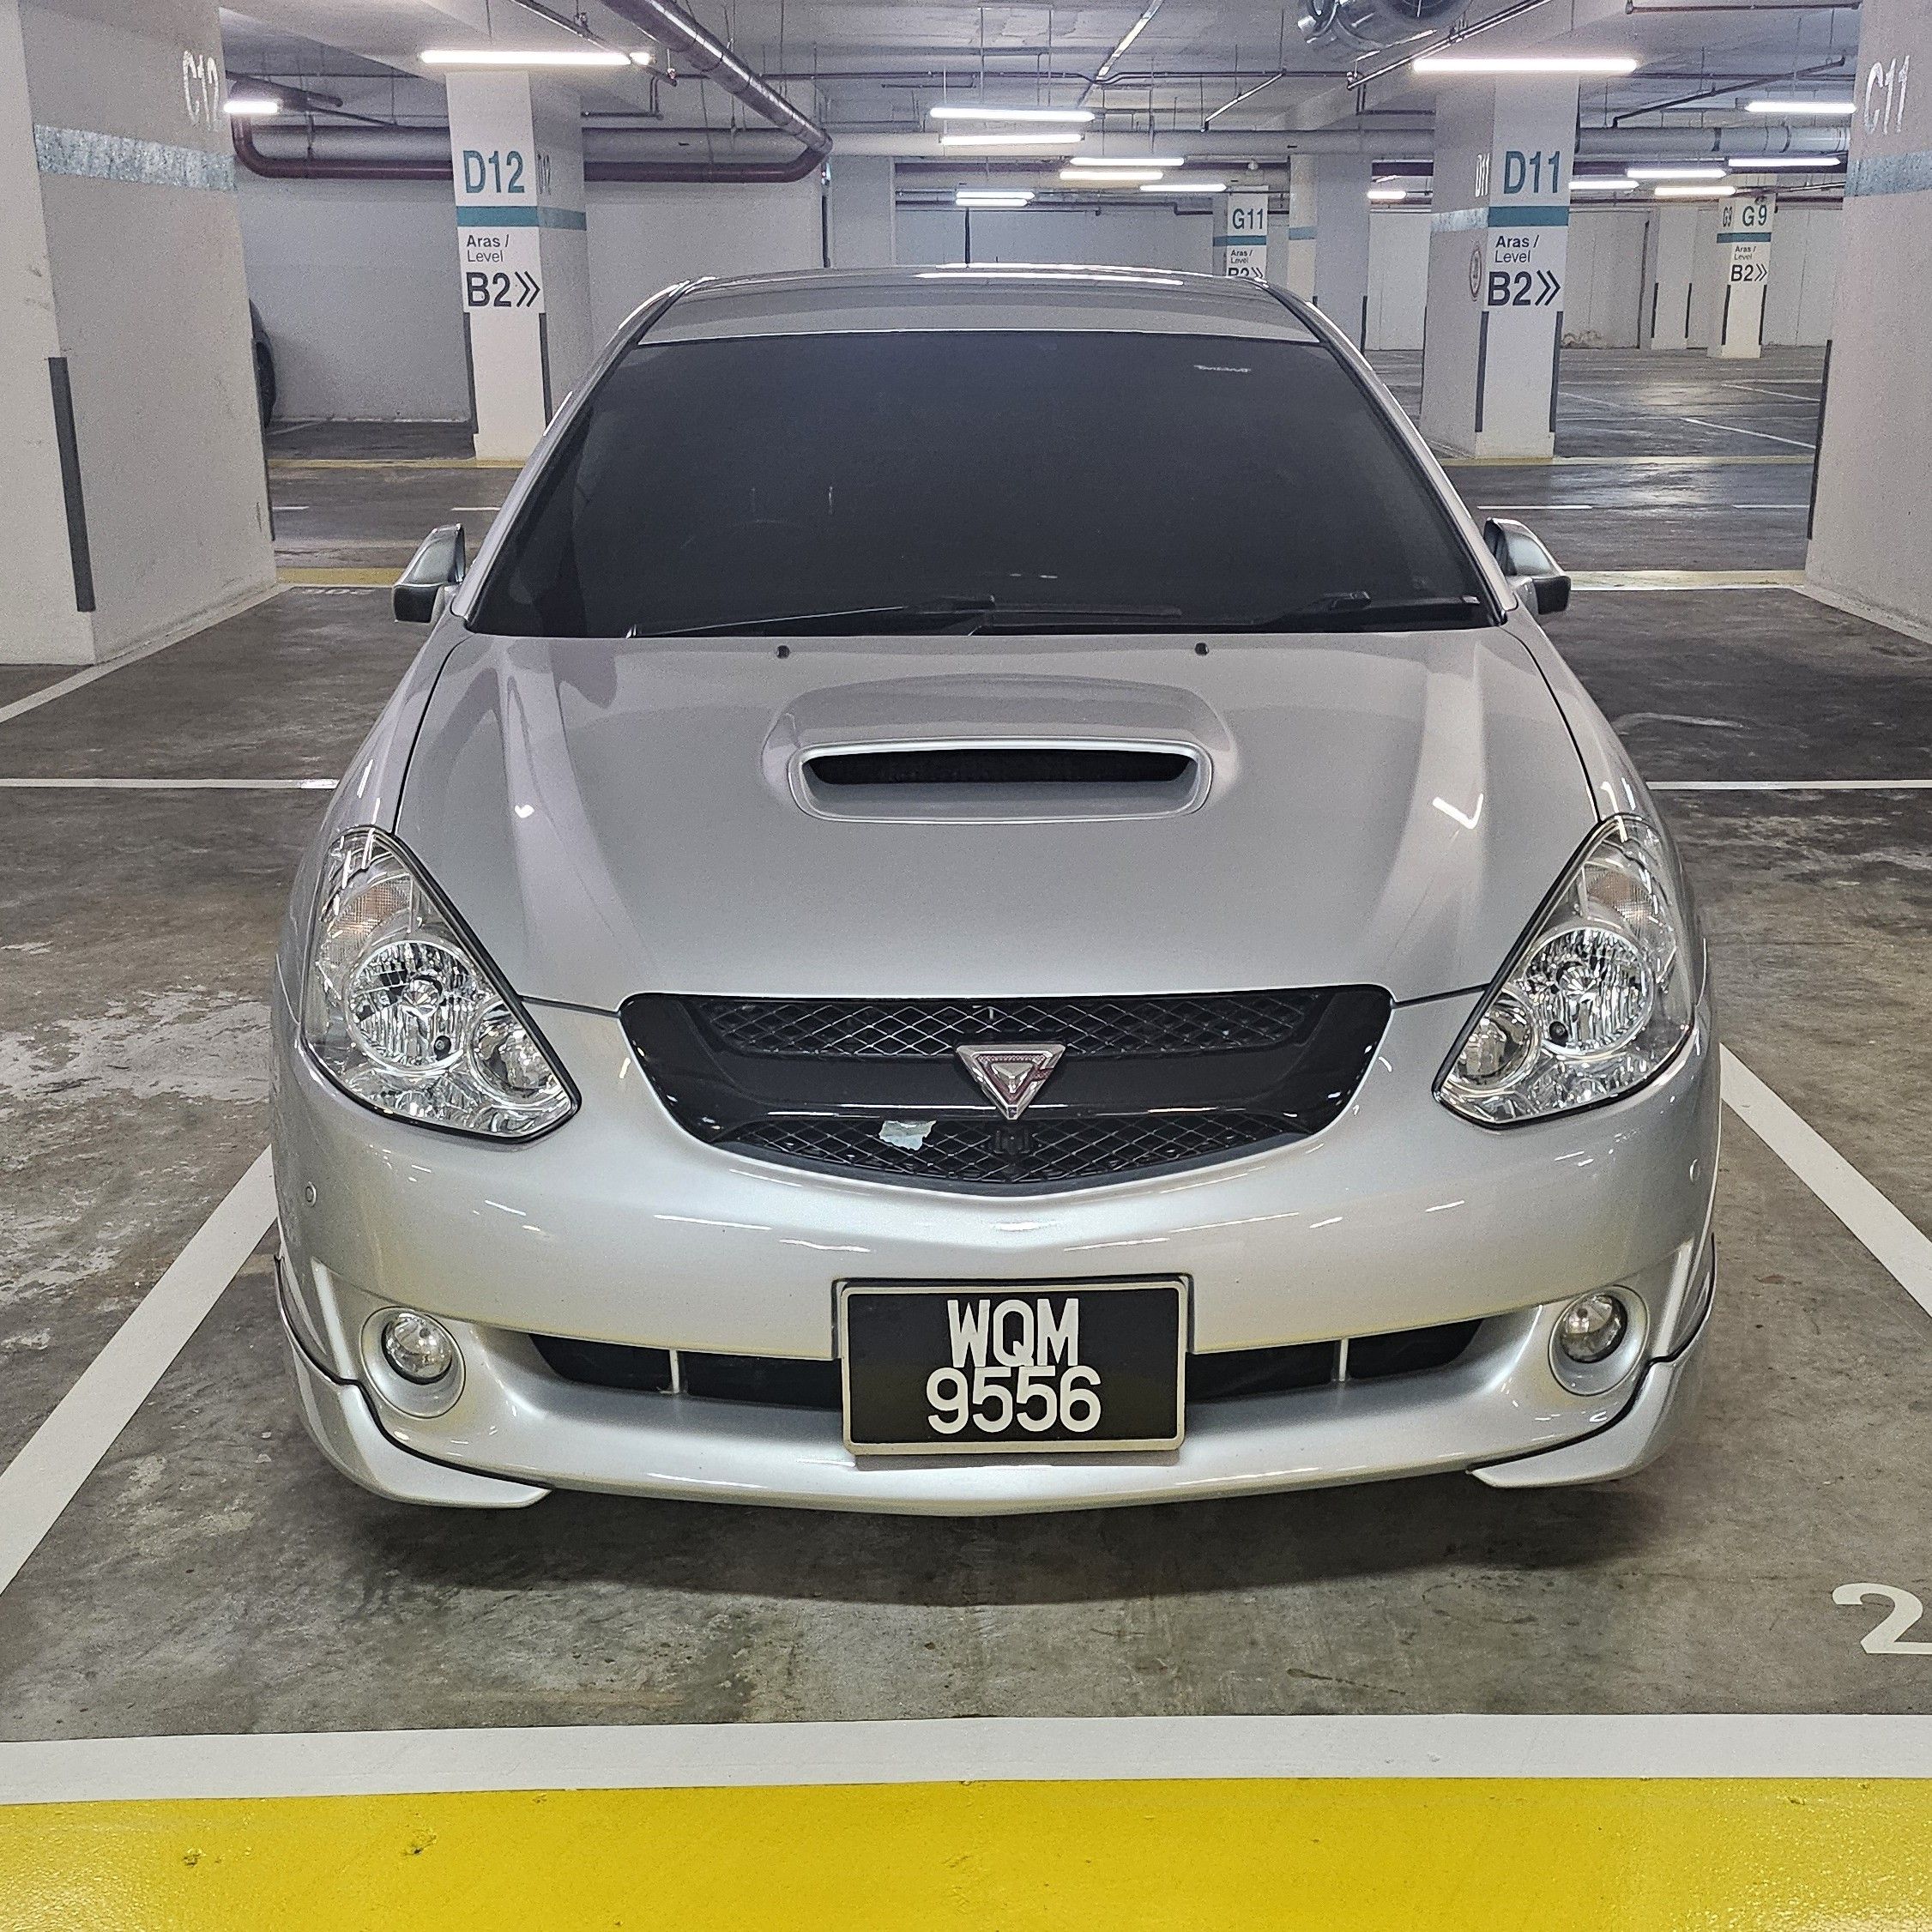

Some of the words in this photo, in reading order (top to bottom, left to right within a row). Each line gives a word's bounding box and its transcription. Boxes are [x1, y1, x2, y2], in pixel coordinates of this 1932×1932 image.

[183, 51, 220, 130] C12
[1864, 55, 1910, 135] C11
[463, 150, 525, 194] D12
[1475, 153, 1490, 197] D11
[1504, 150, 1561, 194] D11
[1232, 208, 1264, 230] G11
[1742, 205, 1767, 226] G9
[467, 234, 501, 248] Aras
[467, 250, 504, 263] Level
[1494, 250, 1531, 263] Level
[1495, 235, 1530, 248] Aras
[466, 271, 512, 307] B2
[1488, 270, 1532, 306] B2
[1730, 263, 1754, 282] B2
[947, 1298, 1078, 1367] WQM
[926, 1365, 1102, 1434] 9556
[1832, 1582, 1932, 1655] 2
